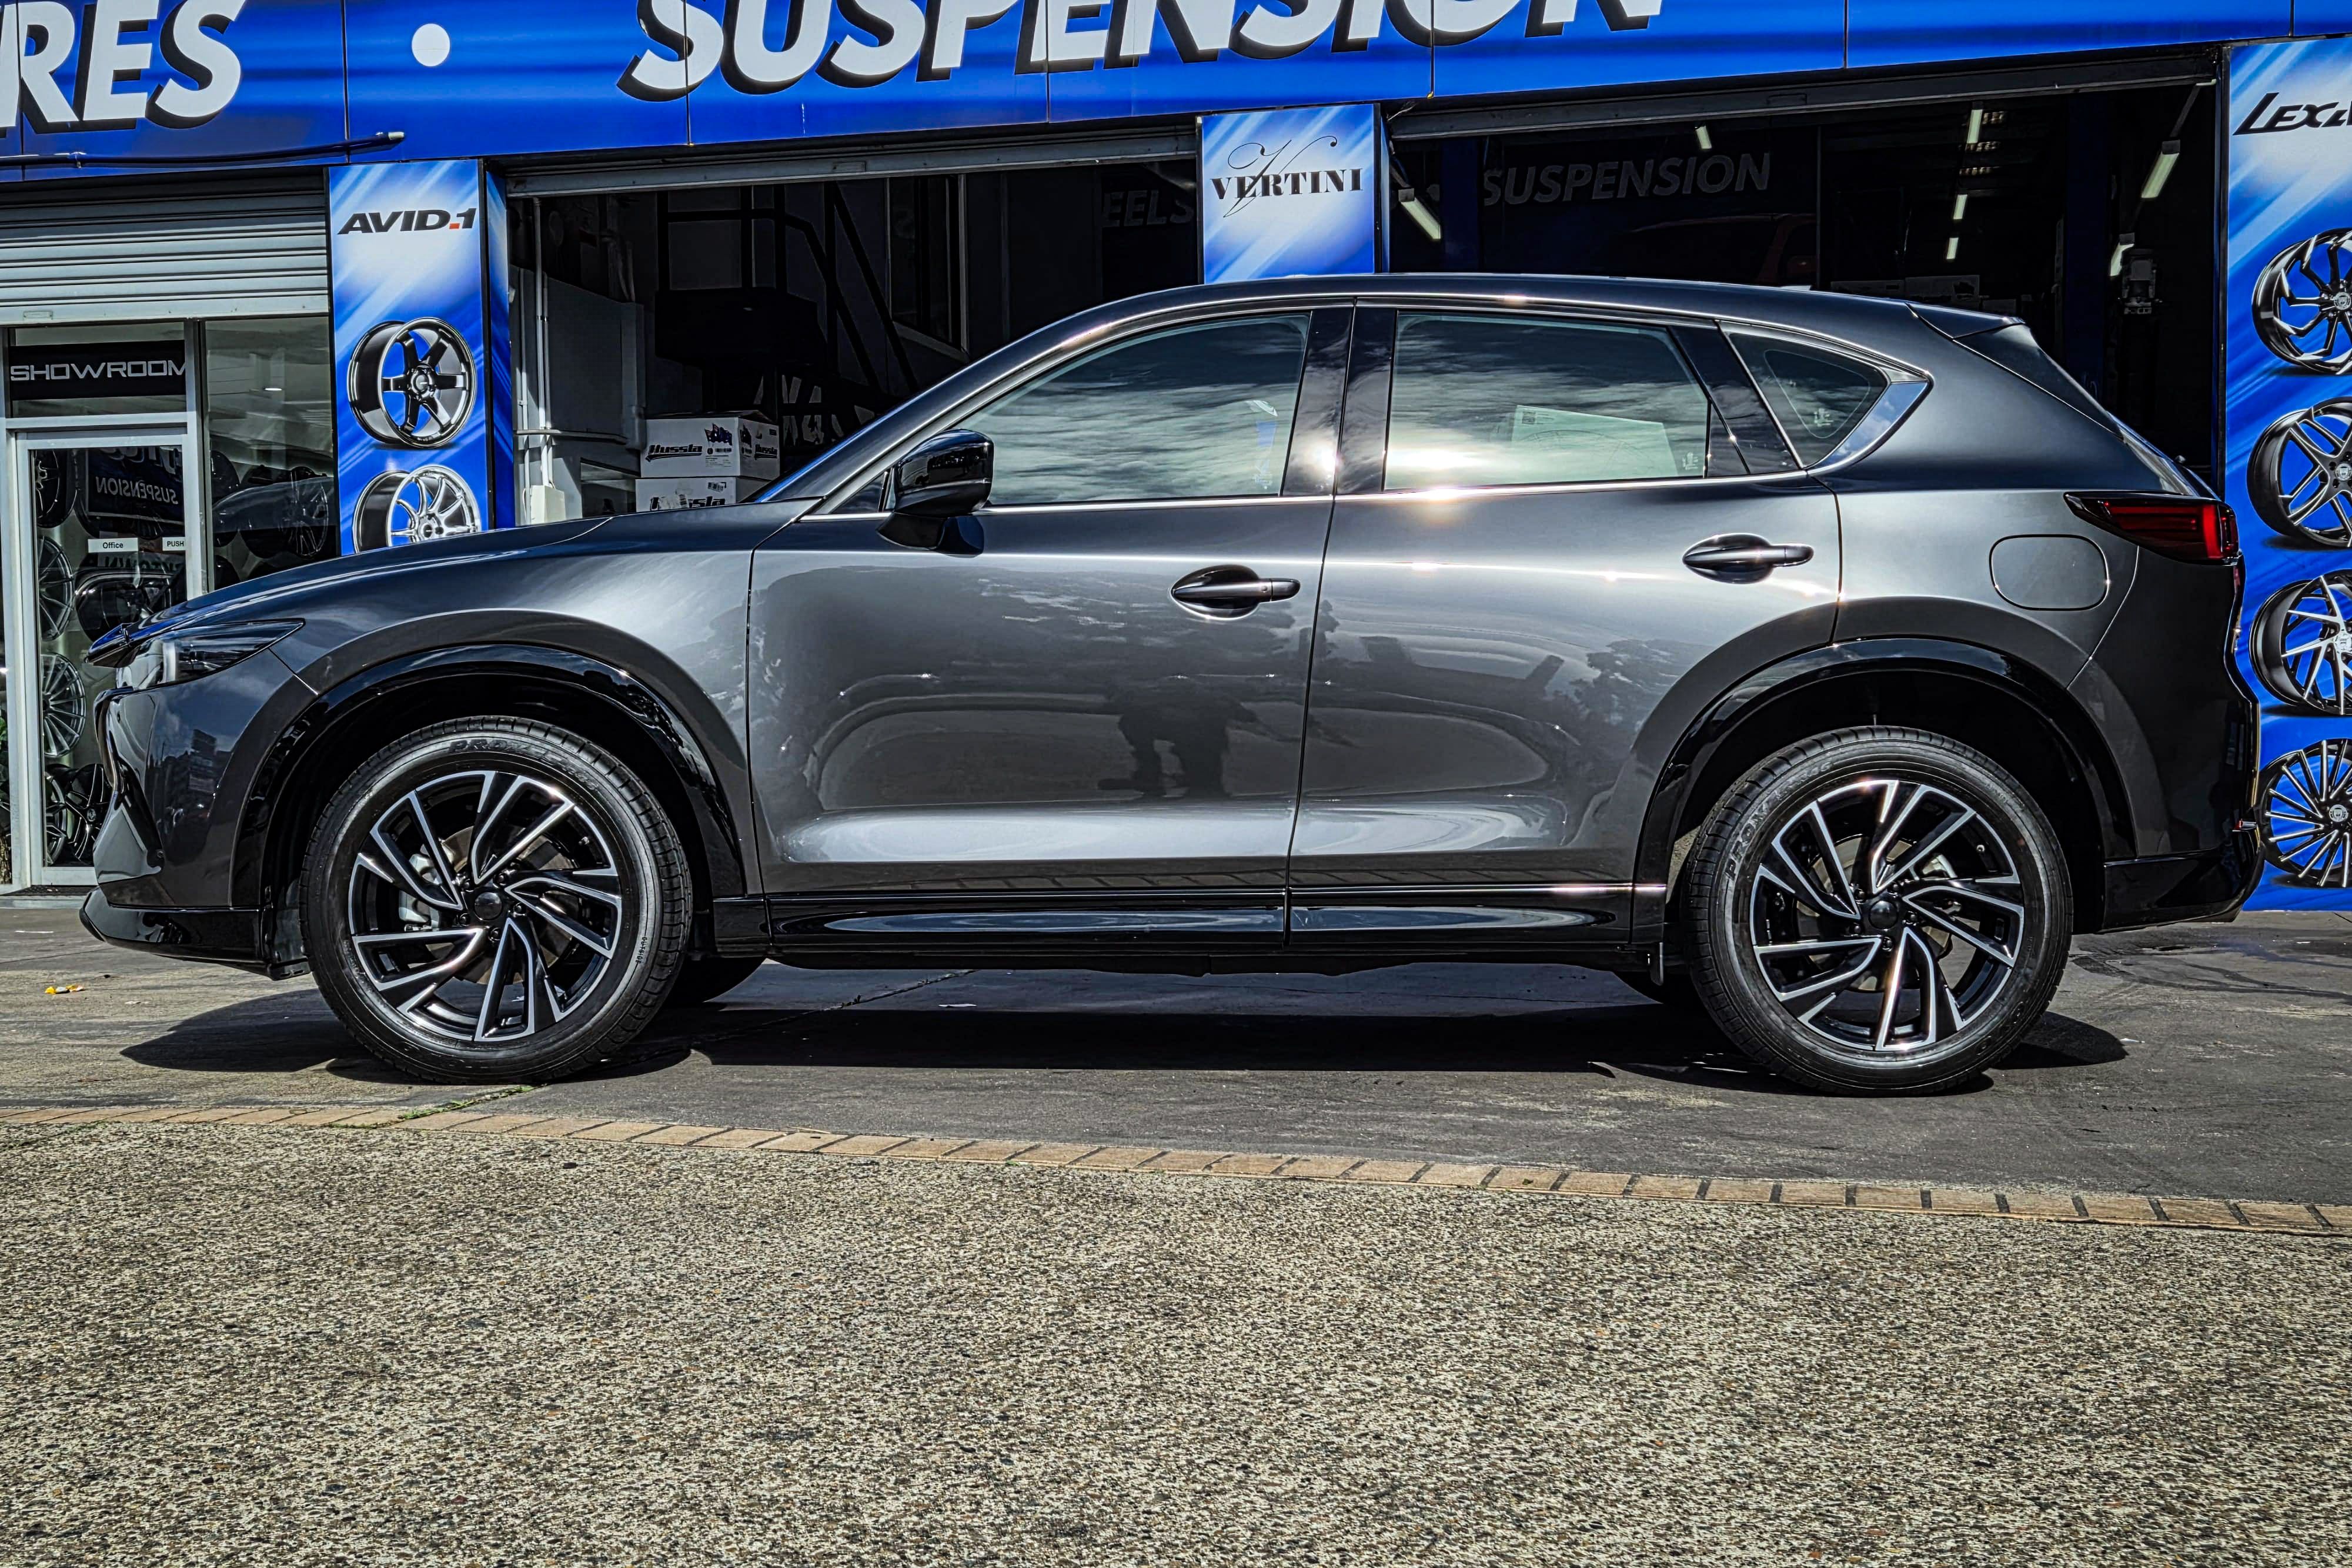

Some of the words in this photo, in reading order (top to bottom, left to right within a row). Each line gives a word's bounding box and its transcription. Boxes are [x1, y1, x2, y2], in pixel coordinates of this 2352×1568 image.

[631, 0, 1663, 90] SUSPE
[0, 0, 246, 128] RES
[1210, 168, 1365, 200] VERTINI
[1482, 151, 1772, 207] SUSPENSION
[337, 207, 477, 235] AVID.1
[10, 359, 186, 382] SHOWROOM
[102, 541, 124, 550] Office
